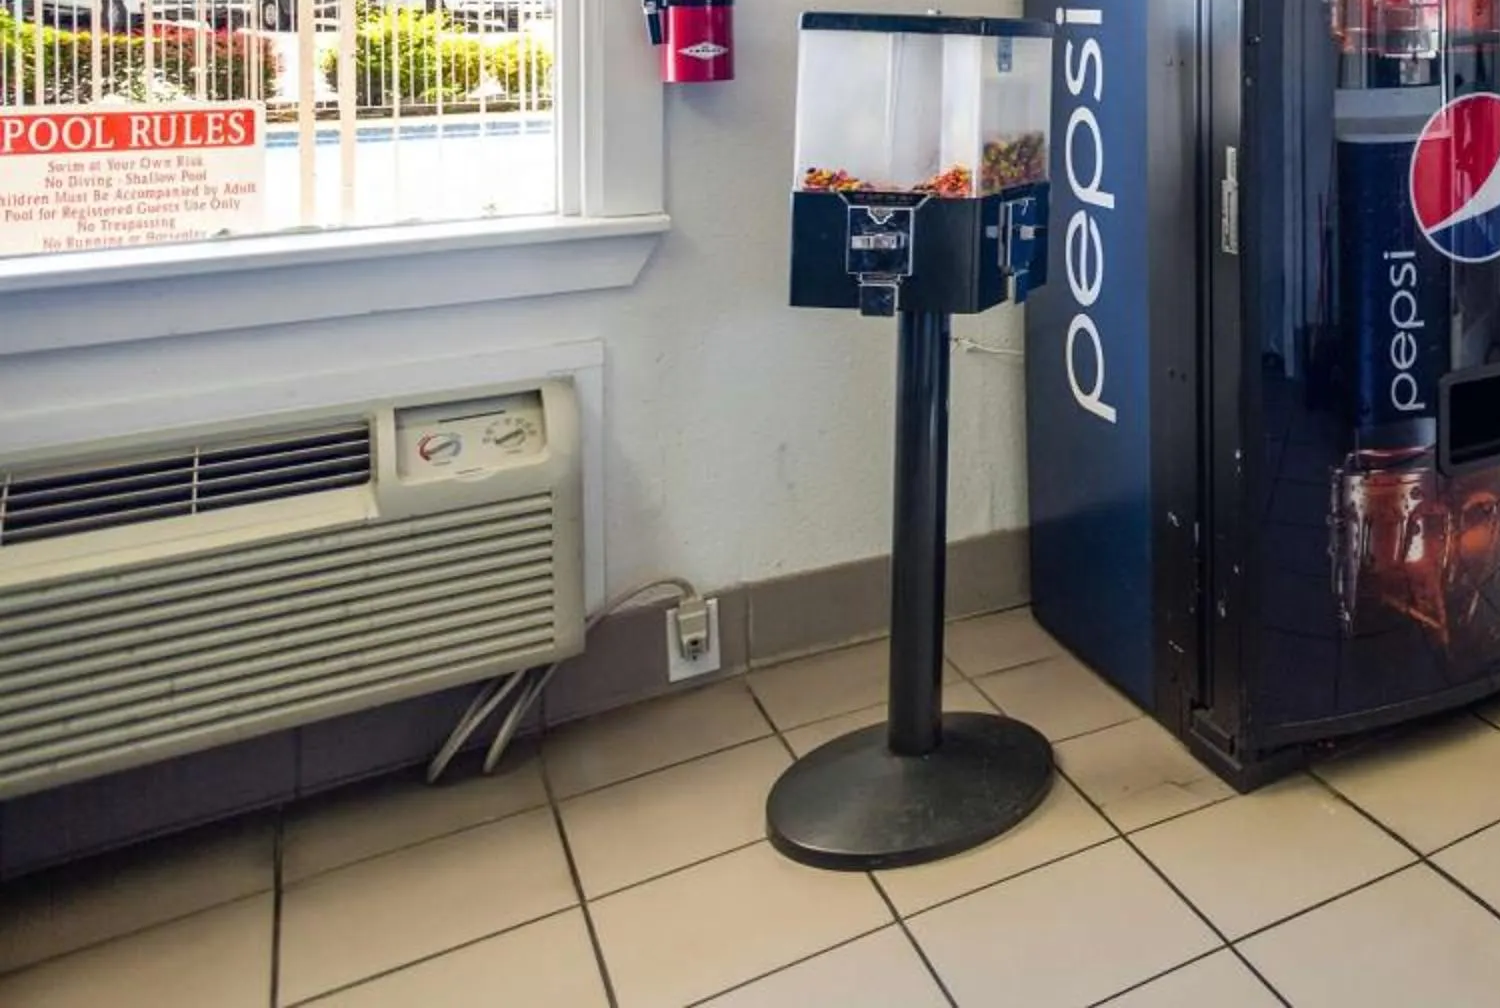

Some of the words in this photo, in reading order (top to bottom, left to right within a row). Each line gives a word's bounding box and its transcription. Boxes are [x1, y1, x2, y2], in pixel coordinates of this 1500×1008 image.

[1, 116, 116, 152] POOL
[128, 111, 246, 147] RULES
[47, 159, 85, 173] Swim
[107, 158, 136, 171] Your
[139, 156, 171, 169] Own
[176, 155, 203, 168] Risk
[44, 176, 63, 189] No
[68, 174, 113, 189] Diving
[125, 171, 176, 185] Shallow
[181, 169, 207, 182] Pool
[0, 192, 49, 207] hildren
[55, 190, 88, 203] Must
[93, 189, 109, 202] Be
[115, 184, 199, 200] Accompanied
[203, 183, 218, 198] by
[224, 183, 256, 195] Adult
[5, 209, 33, 222] Pool
[39, 207, 57, 221] for
[62, 204, 133, 220] Registered
[136, 201, 179, 215] Guests
[184, 199, 207, 211] Use
[210, 196, 241, 211] Only
[1056, 7, 1116, 424] pepsi
[77, 220, 96, 233] No
[99, 218, 176, 233] Trespassing
[43, 236, 62, 250] No
[66, 234, 124, 249] Running
[1383, 249, 1425, 412] pepsi
